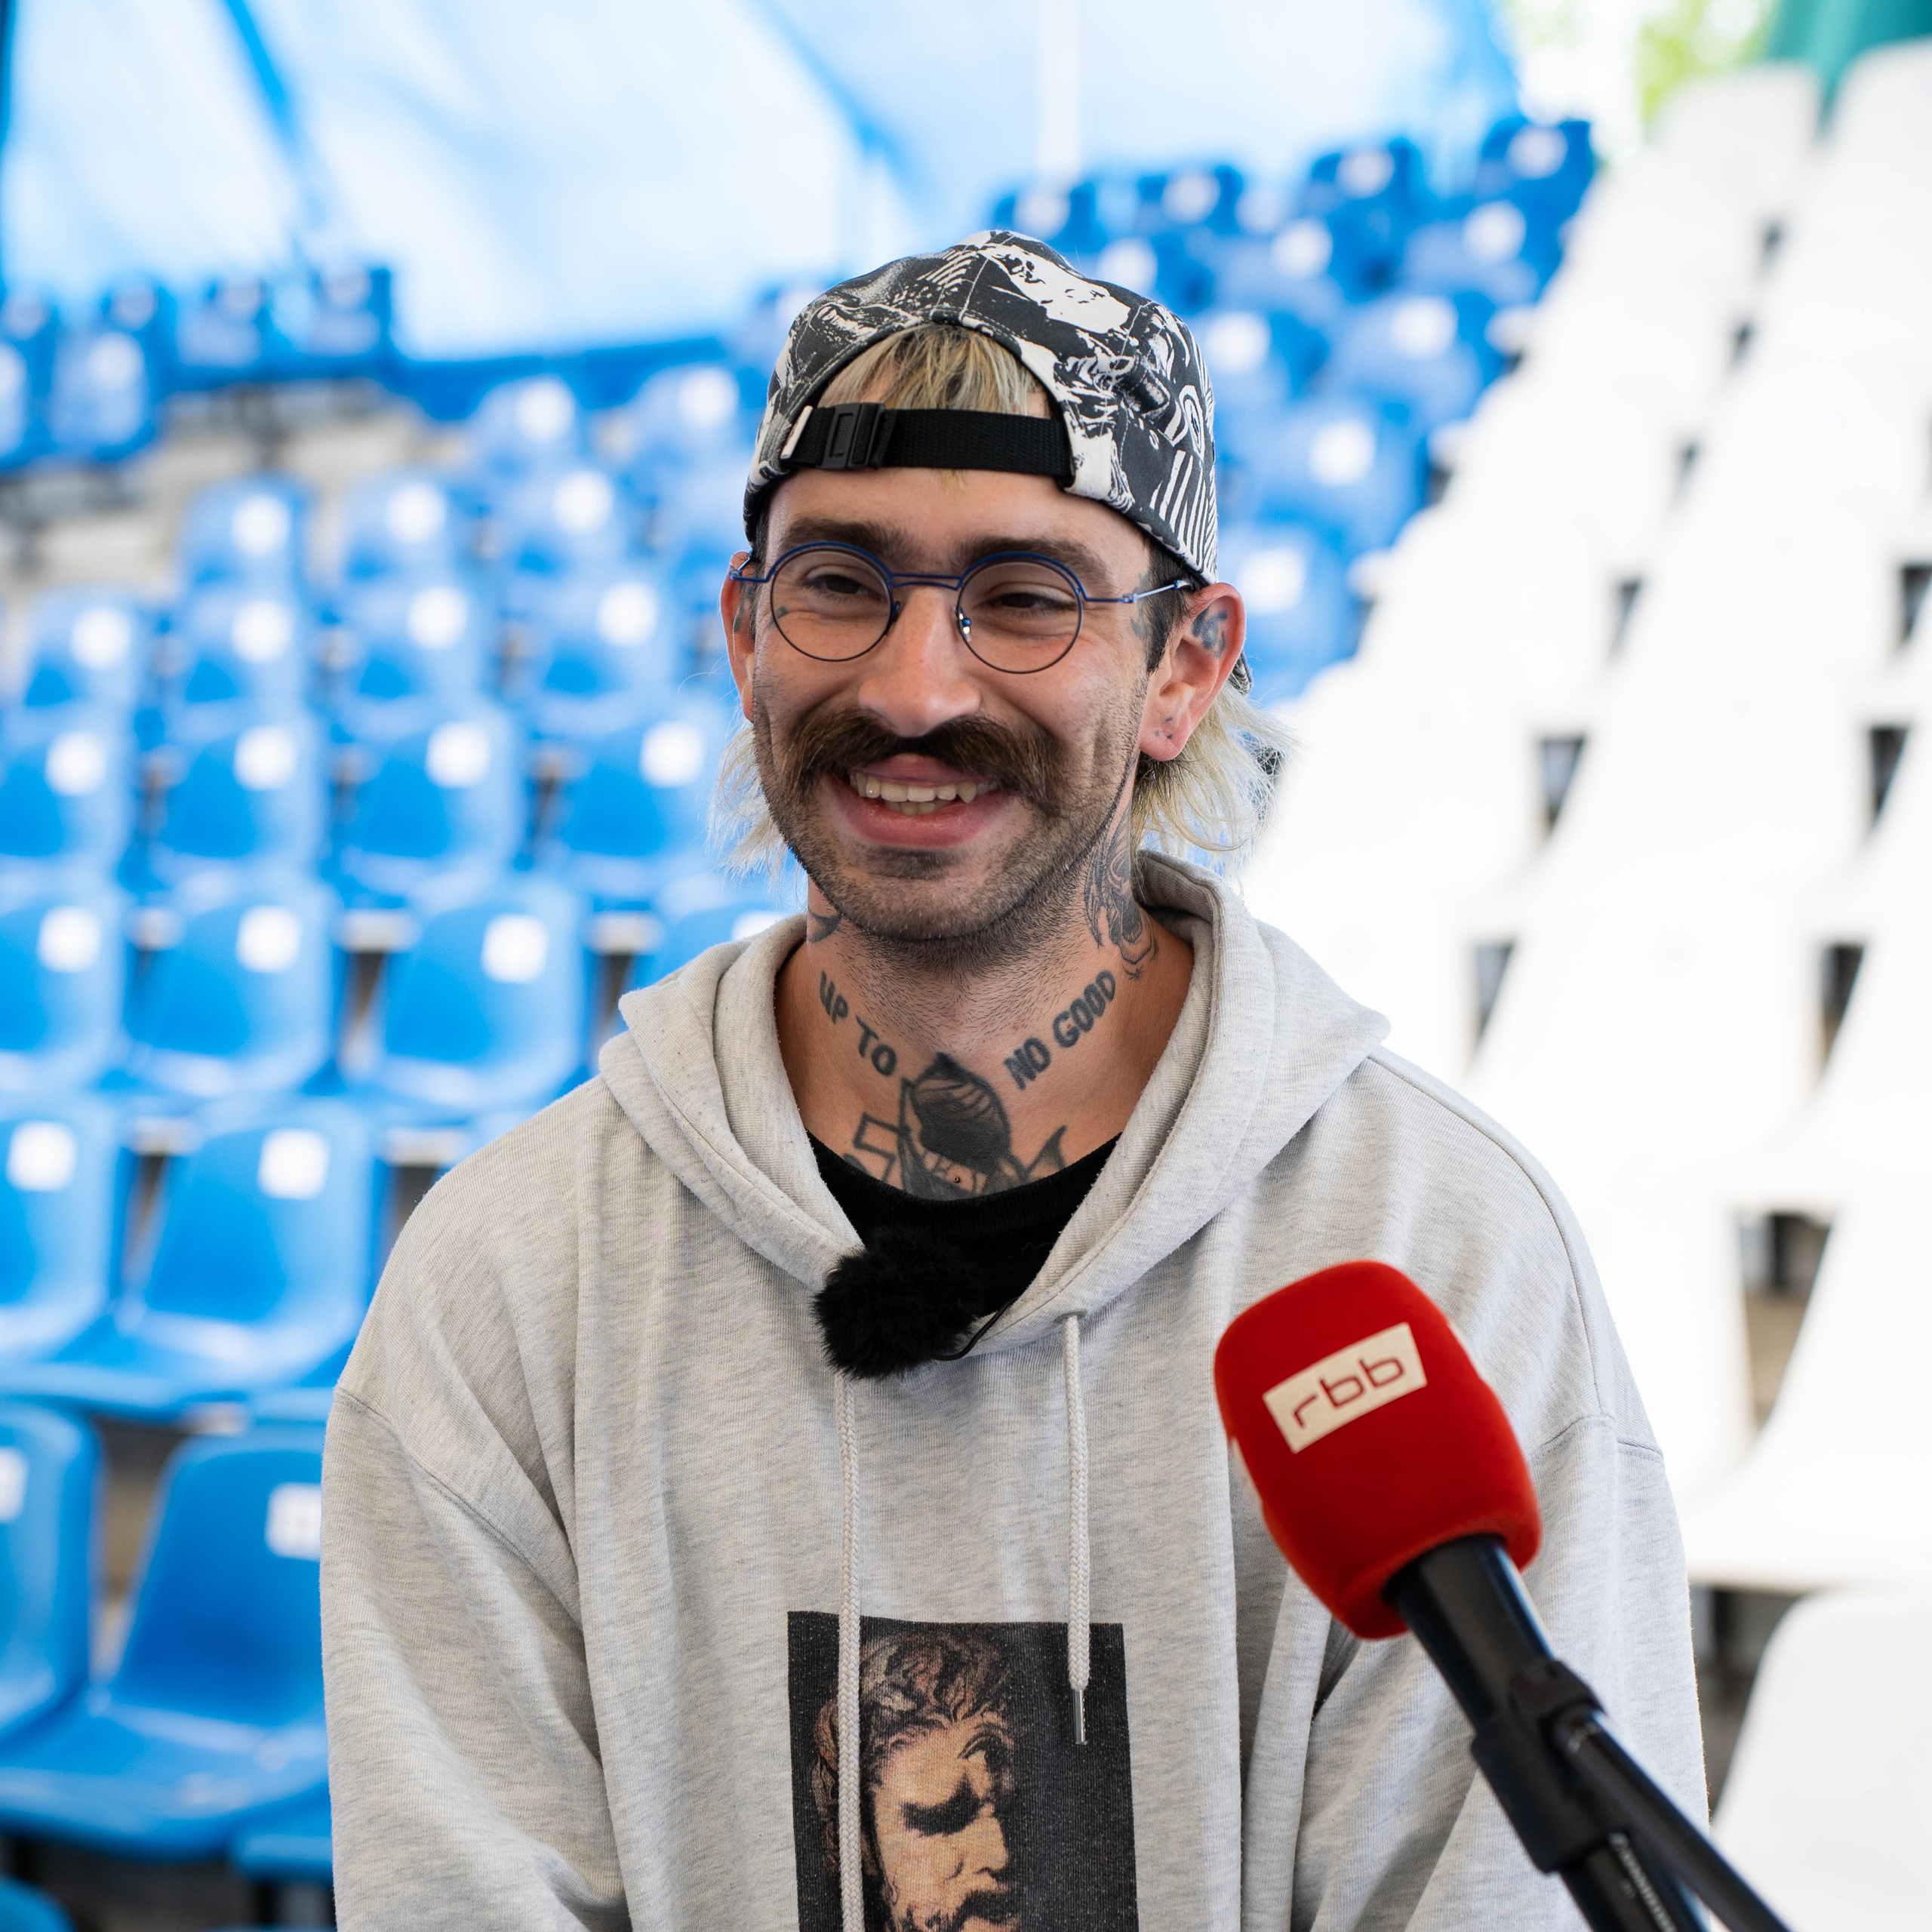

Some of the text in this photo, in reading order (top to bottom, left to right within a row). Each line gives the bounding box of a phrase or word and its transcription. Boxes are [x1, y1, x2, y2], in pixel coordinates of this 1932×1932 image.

[820, 970, 1117, 1091] UP TO NO GOOD
[1293, 1358, 1404, 1429] rbb
